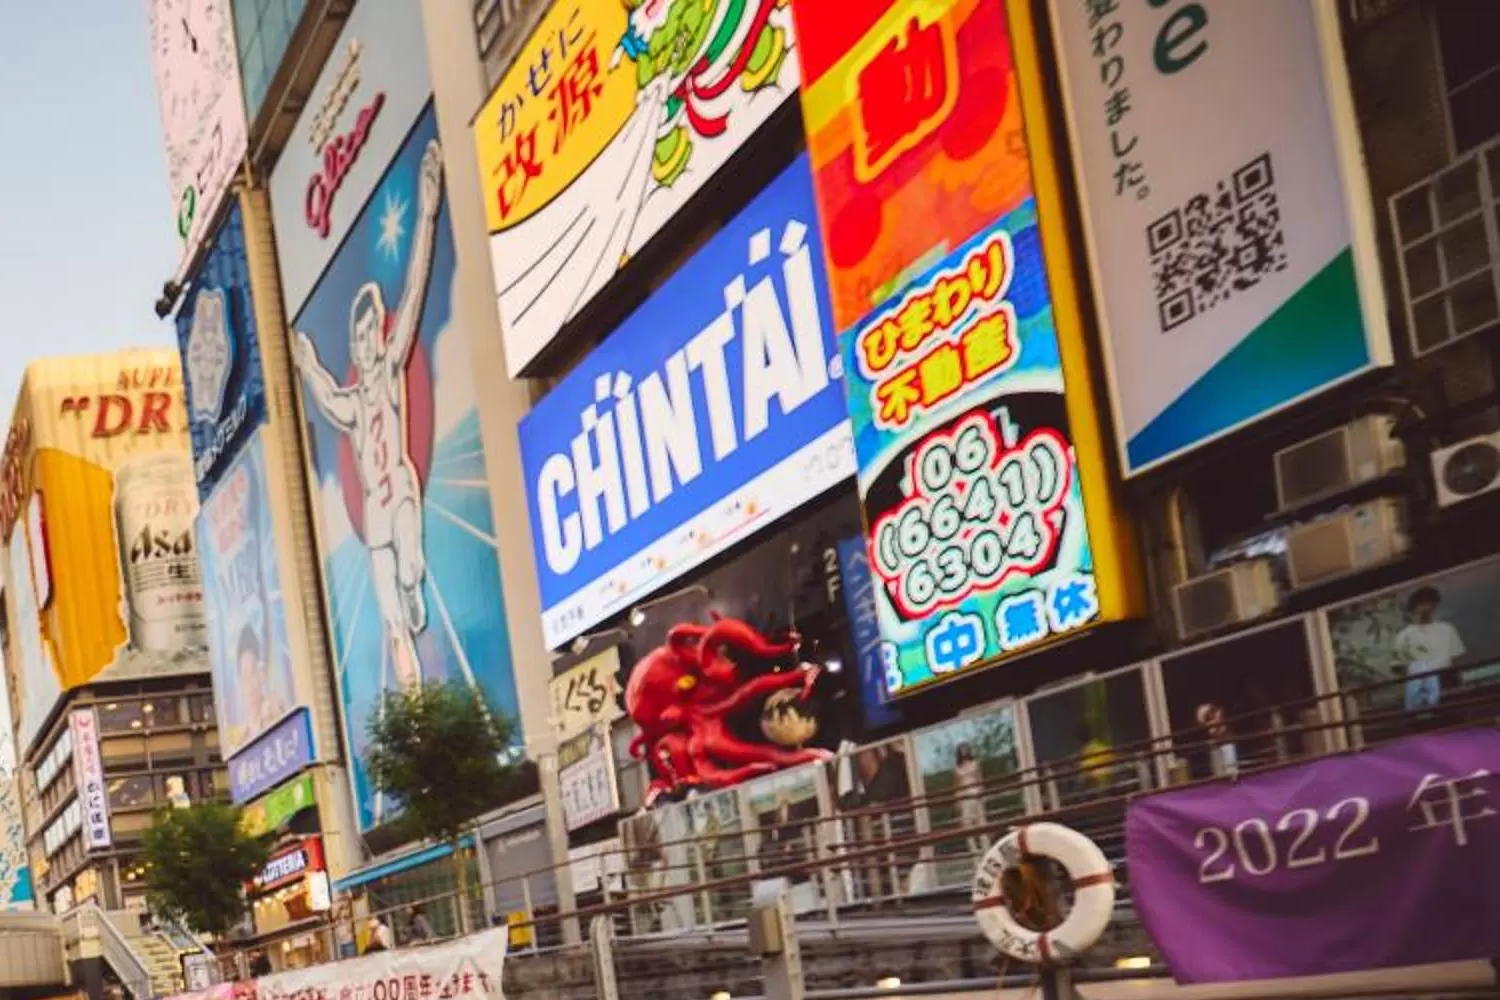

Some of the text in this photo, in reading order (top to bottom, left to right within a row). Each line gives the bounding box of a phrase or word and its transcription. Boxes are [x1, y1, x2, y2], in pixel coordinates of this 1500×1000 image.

[497, 7, 584, 143] かぜに
[1148, 0, 1209, 76] e
[306, 92, 386, 239] Glico
[492, 29, 603, 220] 改源
[864, 238, 1007, 371] ひまわり
[116, 365, 178, 391] SUPE
[878, 311, 1013, 425] 不動産
[370, 409, 393, 508] グリコ
[878, 443, 1059, 571] (6641)
[922, 426, 988, 491] 06
[130, 525, 193, 563] Asa
[906, 511, 1042, 607] 6304
[1194, 768, 1498, 884] 2022 年
